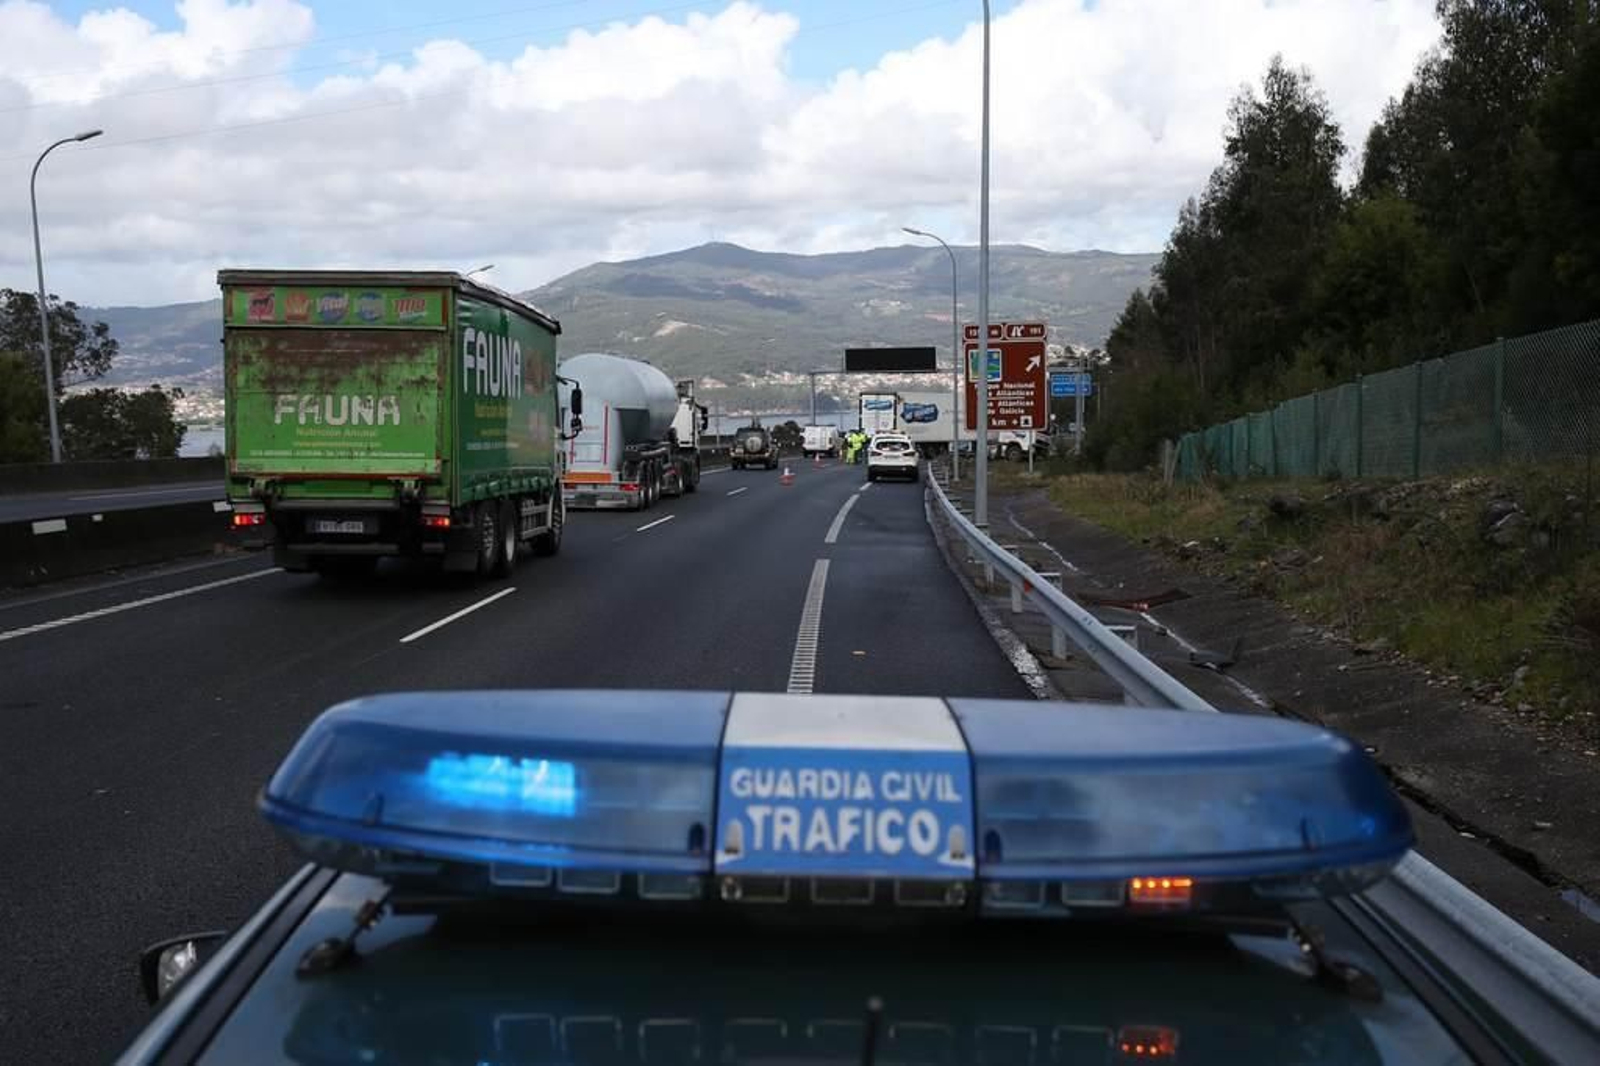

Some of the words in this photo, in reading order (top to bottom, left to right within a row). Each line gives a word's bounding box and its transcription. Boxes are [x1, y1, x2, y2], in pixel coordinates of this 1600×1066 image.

[462, 327, 521, 400] FAUNA
[273, 394, 400, 426] FAUNA
[991, 417, 1007, 426] km
[729, 767, 875, 800] GUARDIA
[880, 770, 963, 803] CIVIL
[745, 804, 941, 856] TRAFICO
